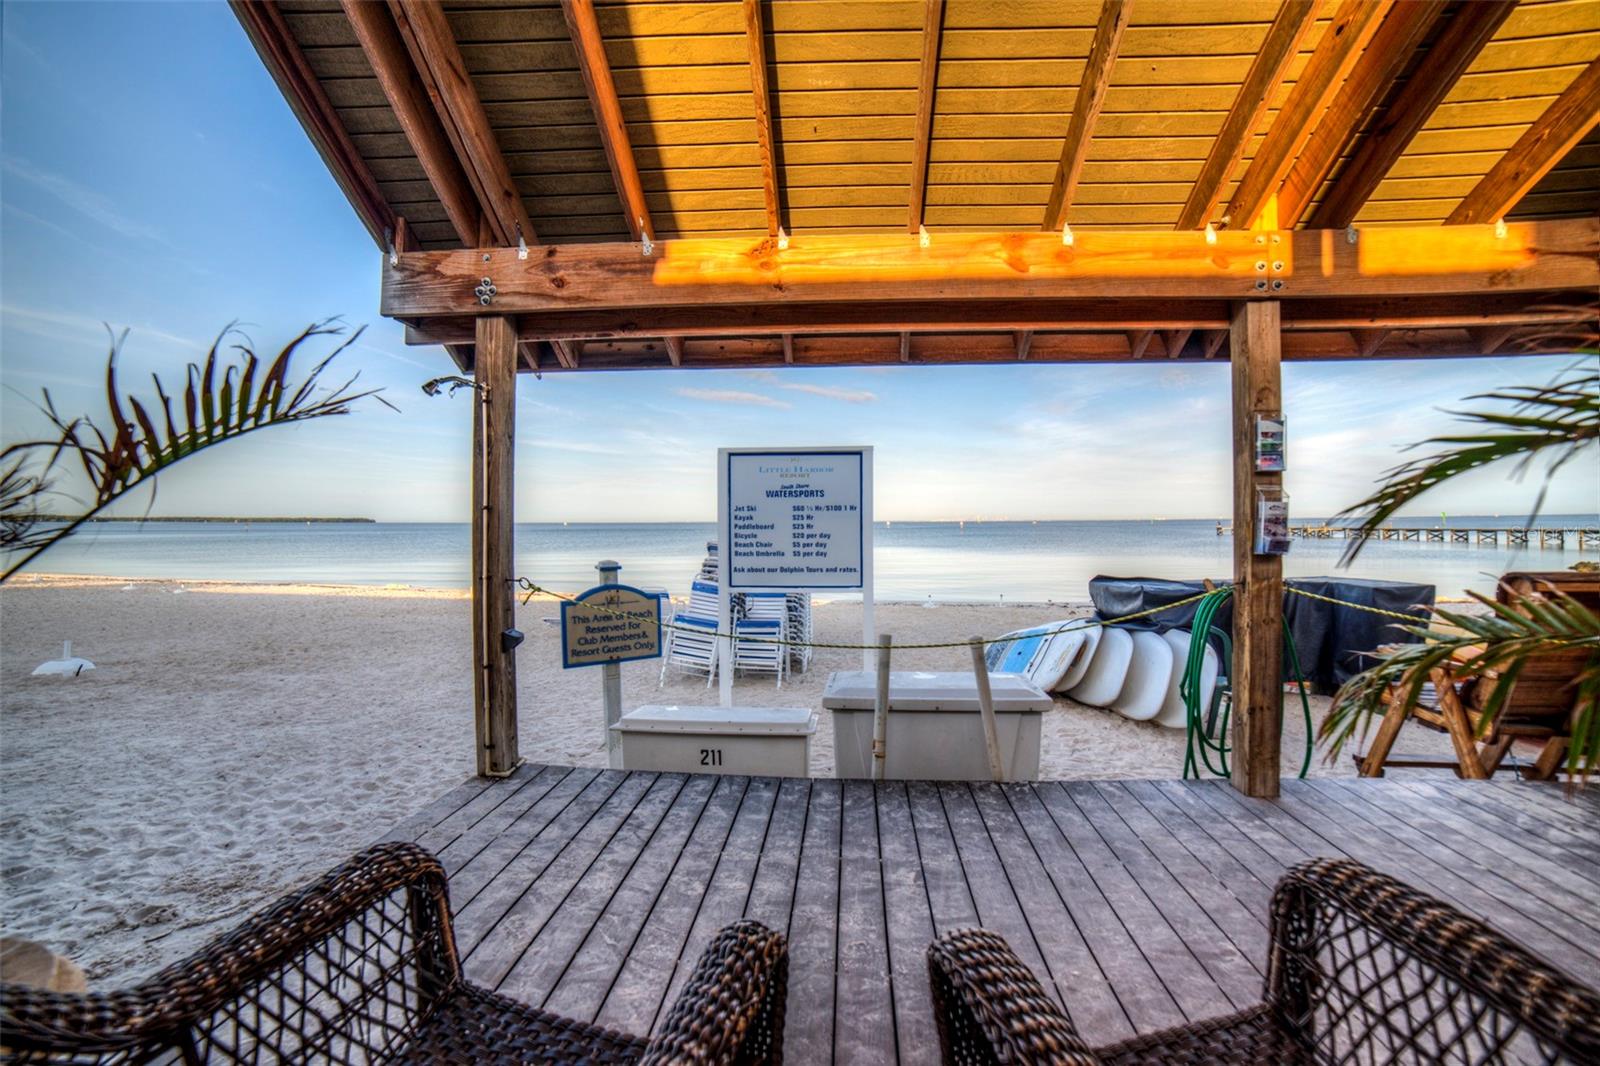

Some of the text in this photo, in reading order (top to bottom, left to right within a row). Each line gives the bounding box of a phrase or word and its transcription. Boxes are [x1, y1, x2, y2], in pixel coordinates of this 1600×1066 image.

[766, 489, 825, 498] WATERSPORTS
[734, 532, 758, 540] Bicycle
[815, 541, 827, 549] day
[779, 566, 805, 574] Dolphin
[572, 615, 590, 625] This
[592, 614, 613, 623] Area
[627, 609, 653, 619] Beach
[585, 623, 626, 634] Reserved
[577, 636, 598, 646] Club
[571, 646, 600, 658] Resort
[602, 645, 632, 654] Guests
[700, 749, 722, 766] 211
